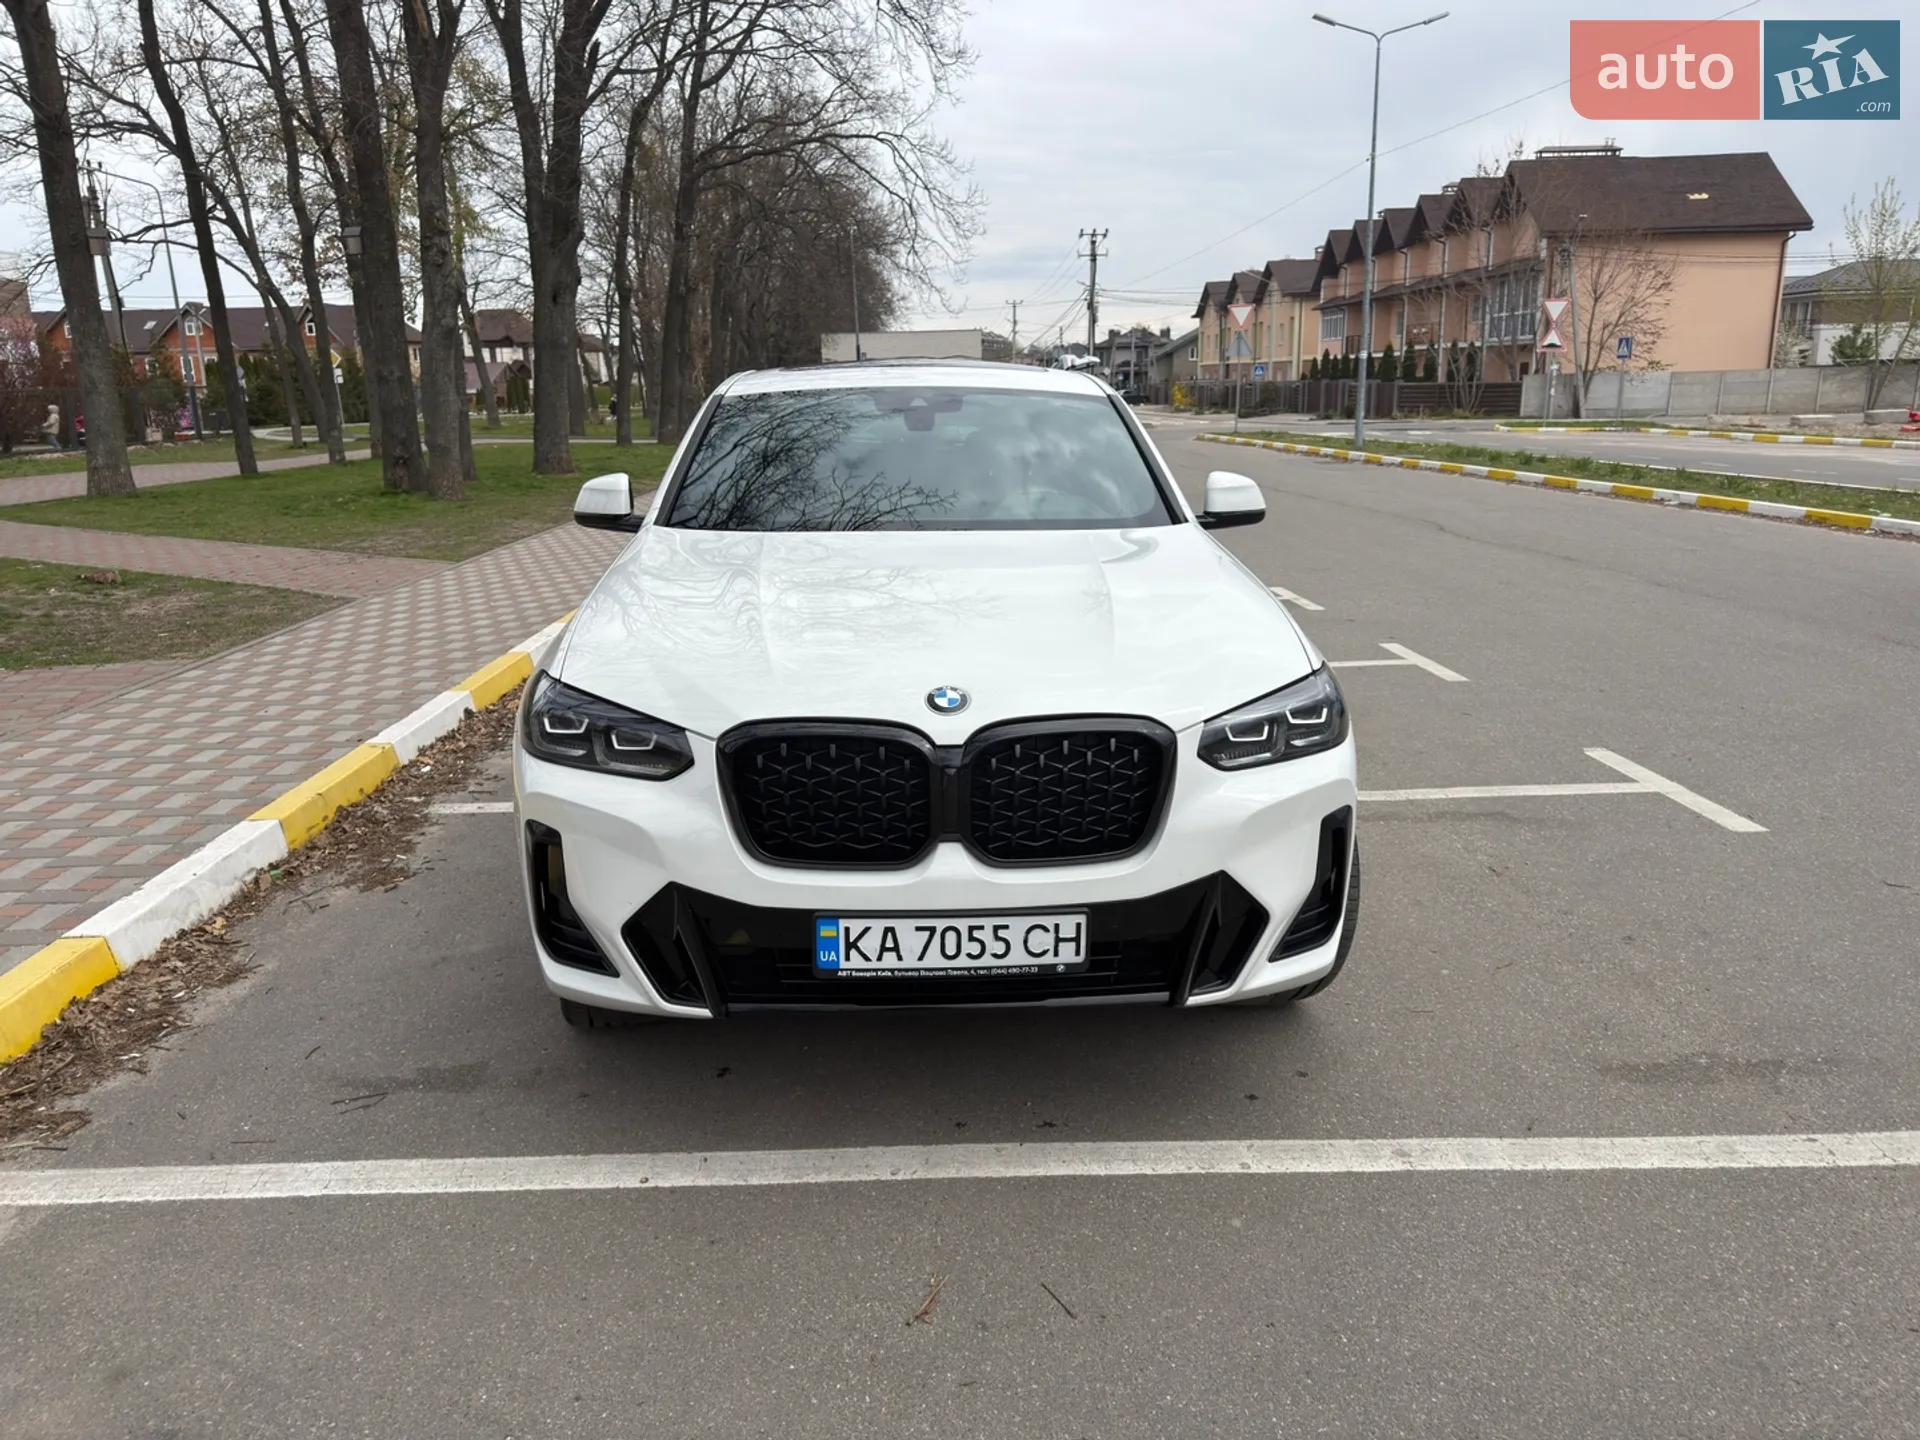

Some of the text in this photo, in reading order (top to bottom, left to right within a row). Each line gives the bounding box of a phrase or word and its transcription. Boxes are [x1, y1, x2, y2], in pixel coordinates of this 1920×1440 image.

[819, 949, 838, 962] UA
[843, 922, 1083, 963] KA 7055 CH
